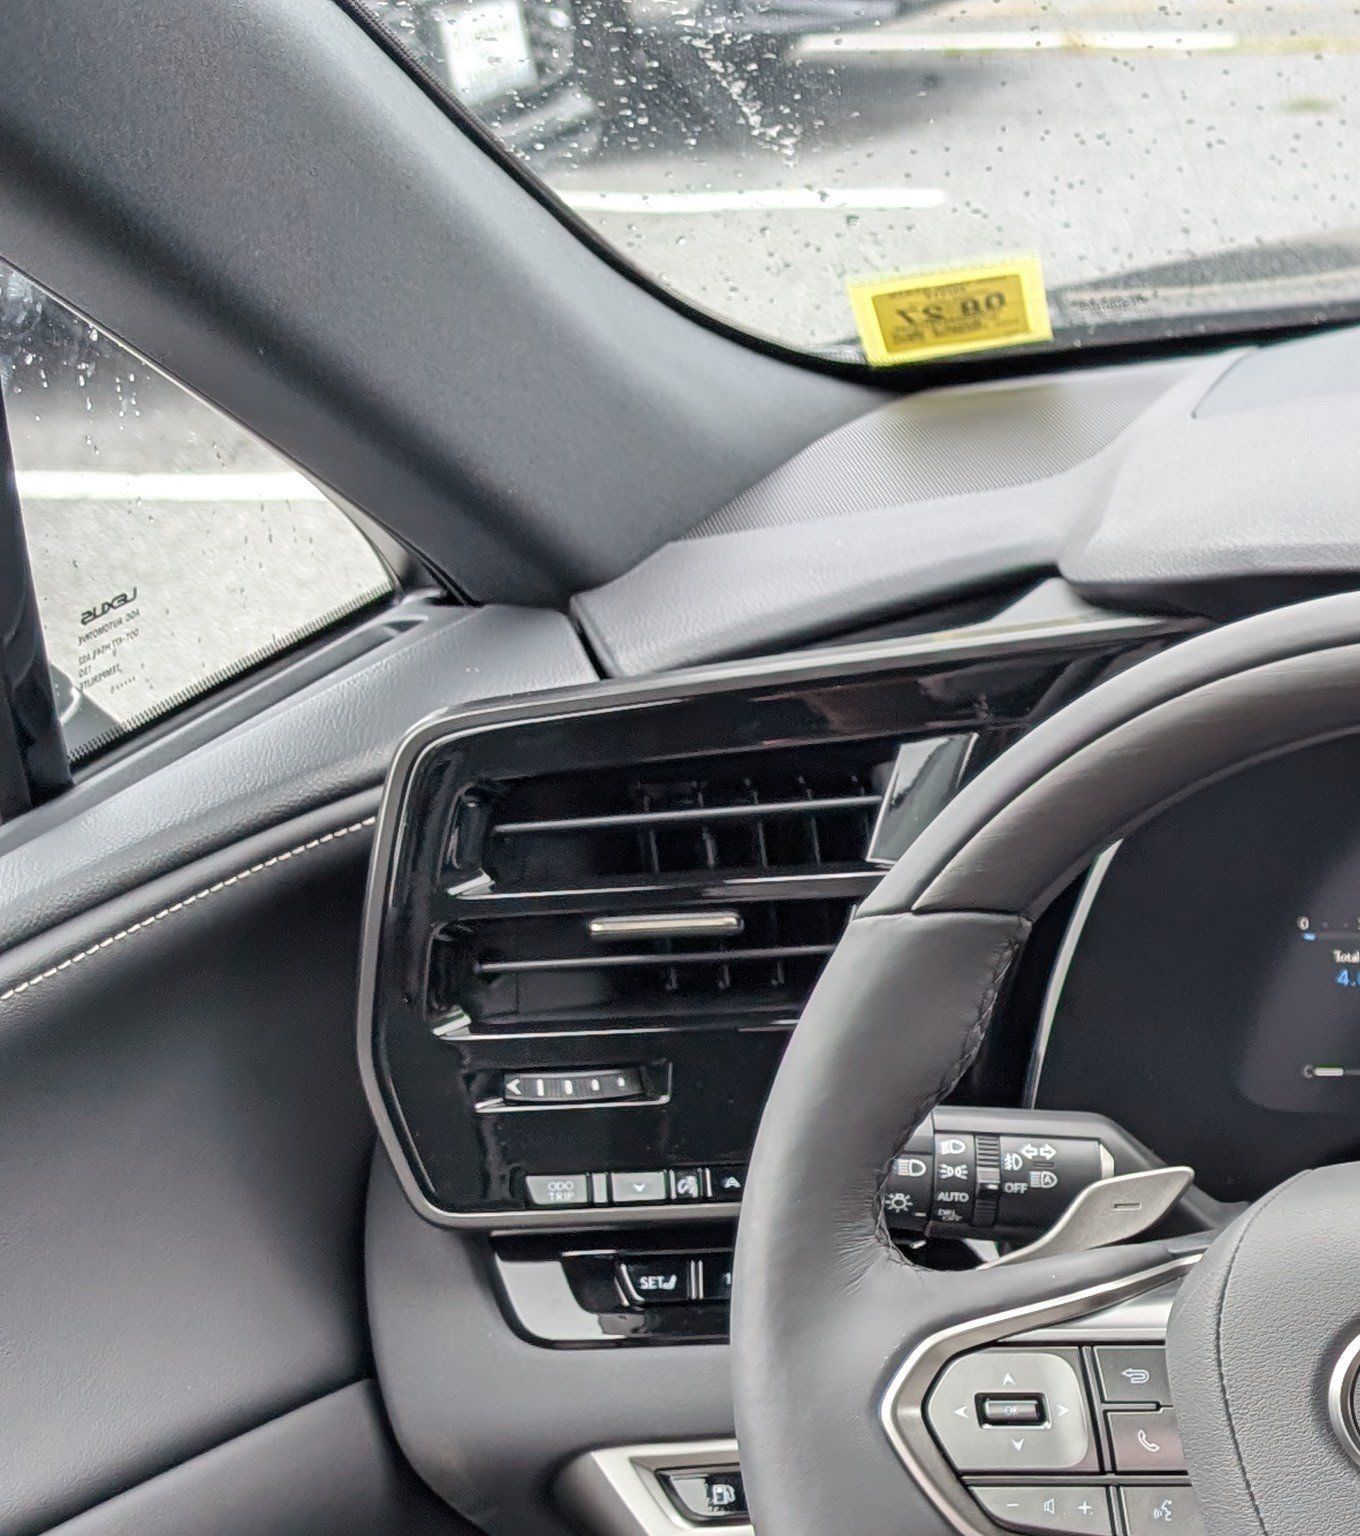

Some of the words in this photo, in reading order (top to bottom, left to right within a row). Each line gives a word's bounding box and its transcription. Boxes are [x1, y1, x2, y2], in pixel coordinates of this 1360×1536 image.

[1299, 917, 1310, 930] 0
[1333, 949, 1360, 963] Total
[1004, 1182, 1028, 1194] OFF
[937, 1192, 969, 1202] AUTO
[640, 1276, 664, 1290] SET
